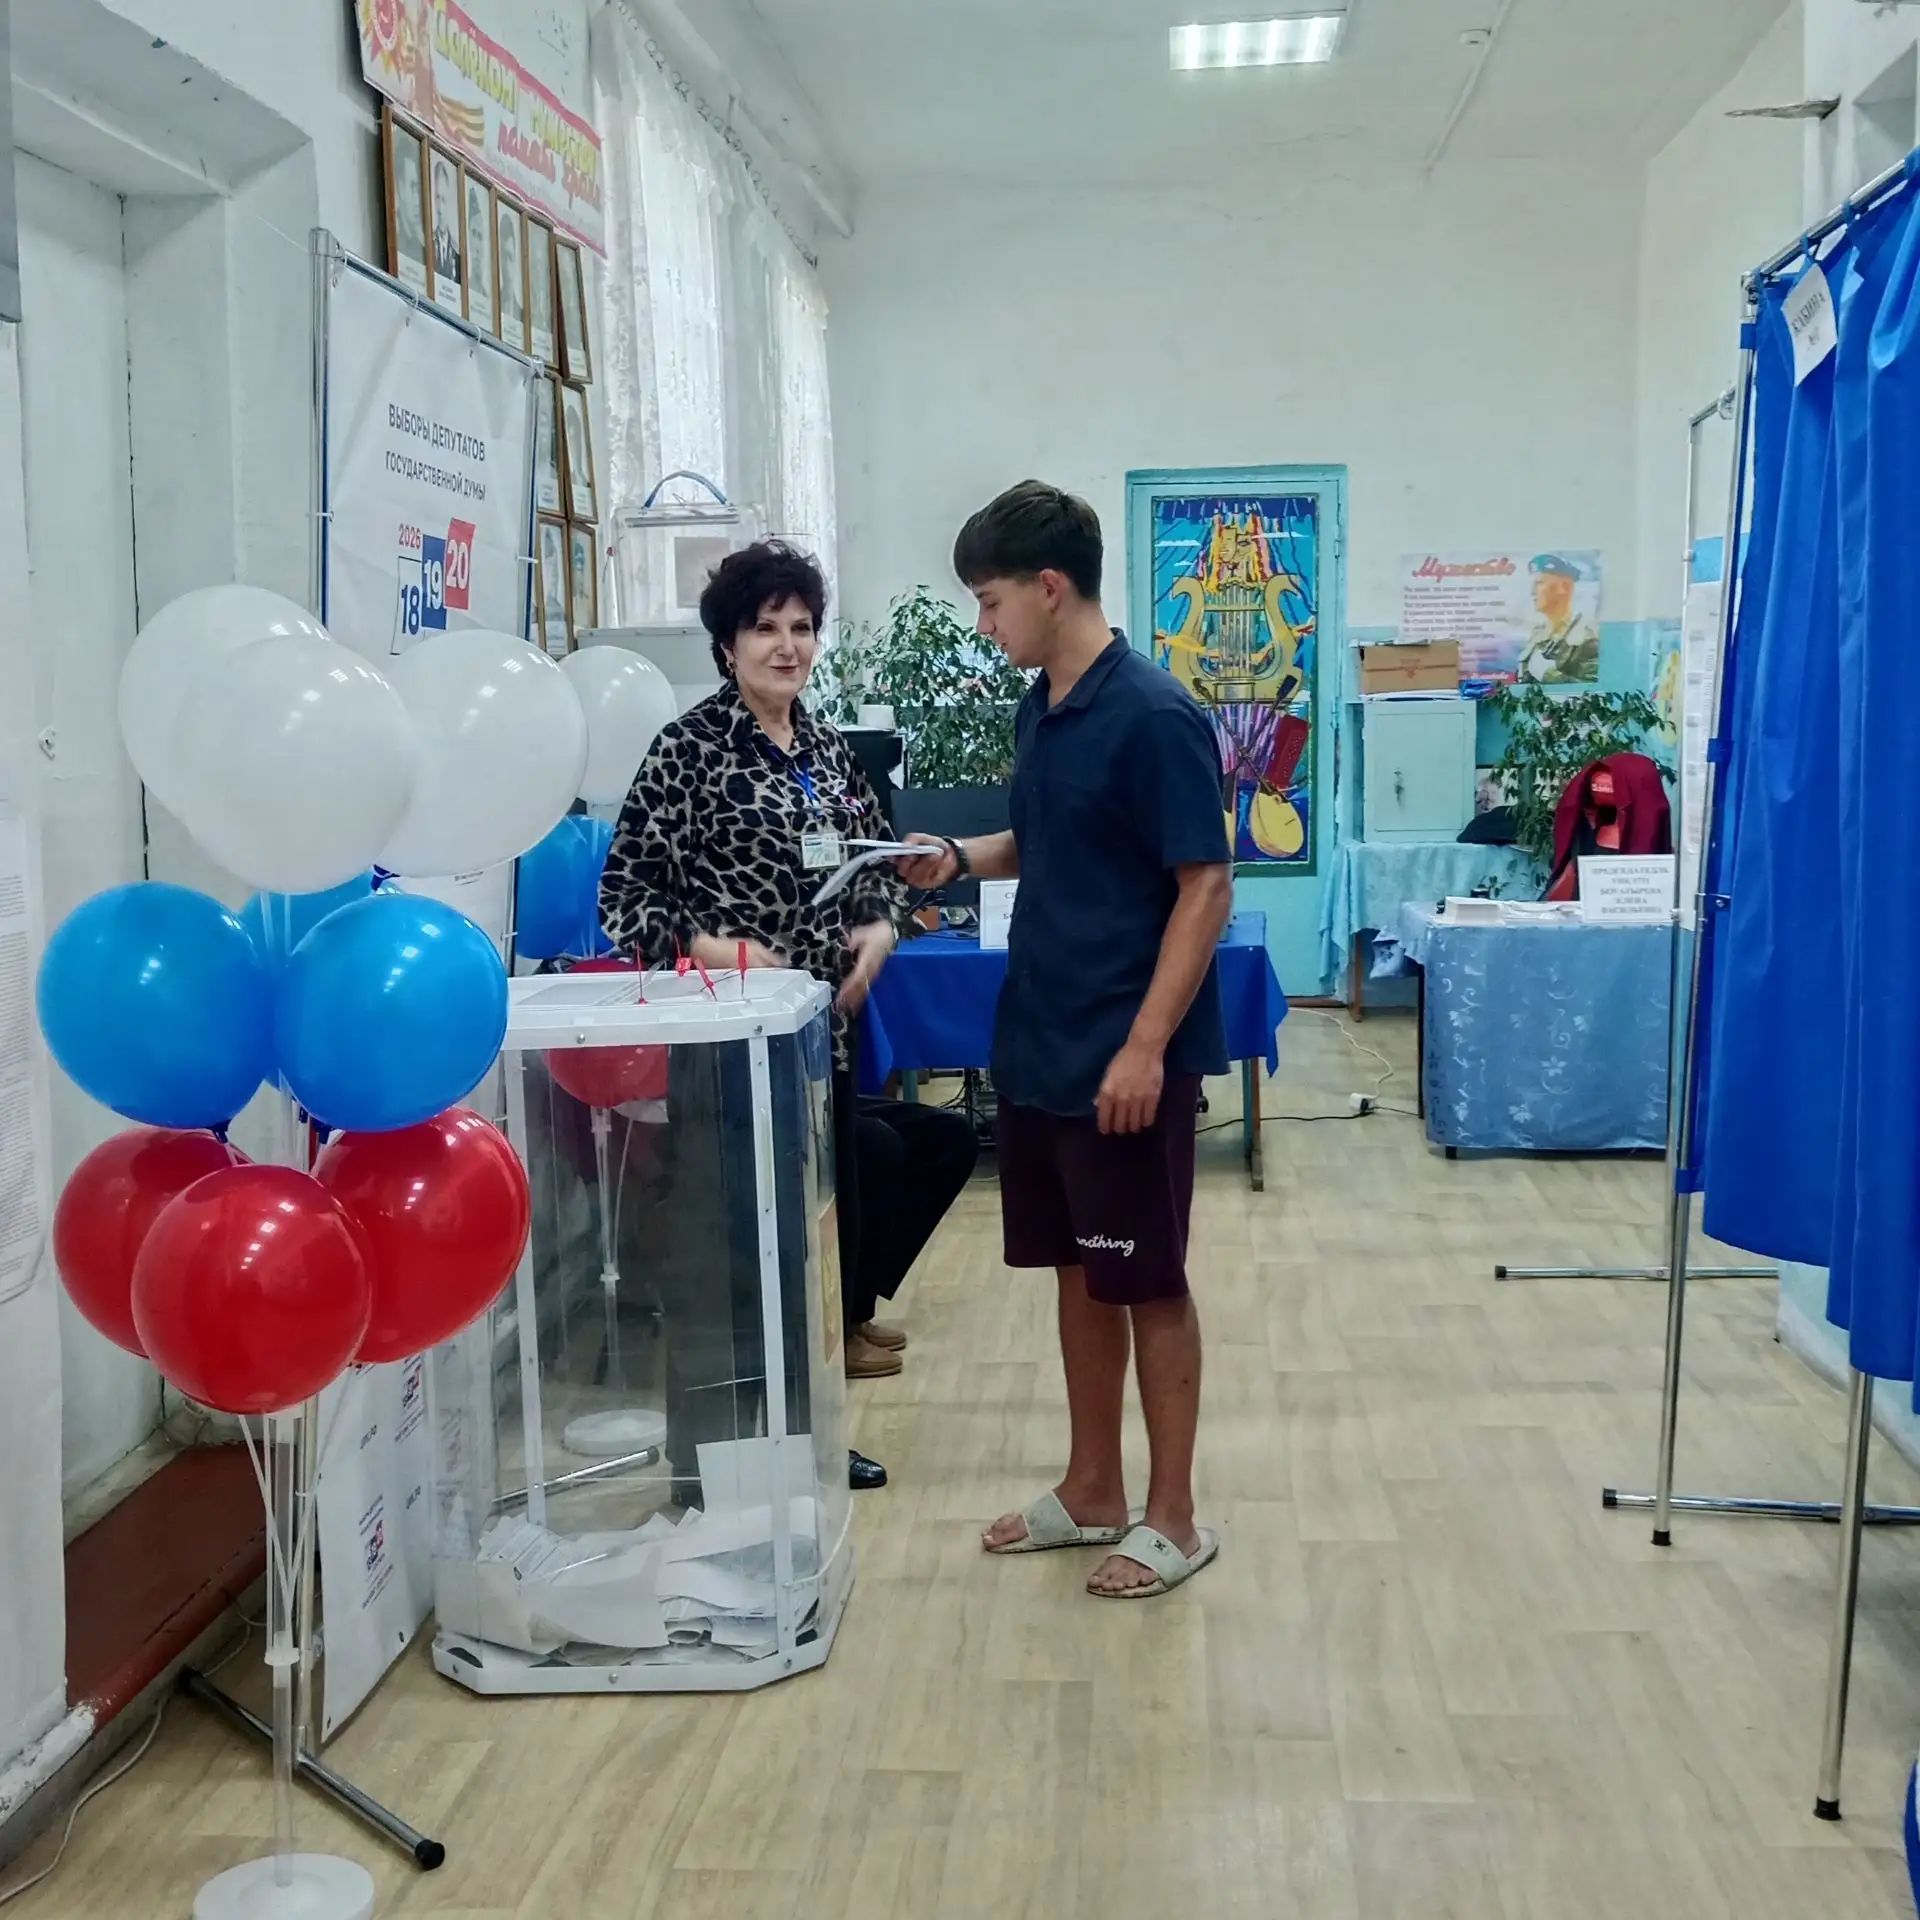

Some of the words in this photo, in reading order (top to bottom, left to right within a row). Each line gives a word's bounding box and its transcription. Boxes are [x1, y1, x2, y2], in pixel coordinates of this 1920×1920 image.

[389, 403, 430, 442] ВЫБОРЫ
[432, 422, 485, 461] ДЕПУТАТОВ
[386, 450, 462, 494] ГОСУДАРСТВЕННОЙ
[464, 478, 486, 501] ДУМЫ
[398, 523, 421, 550] 2026
[424, 560, 441, 610] 19
[446, 539, 469, 590] 20
[401, 584, 420, 636] 18
